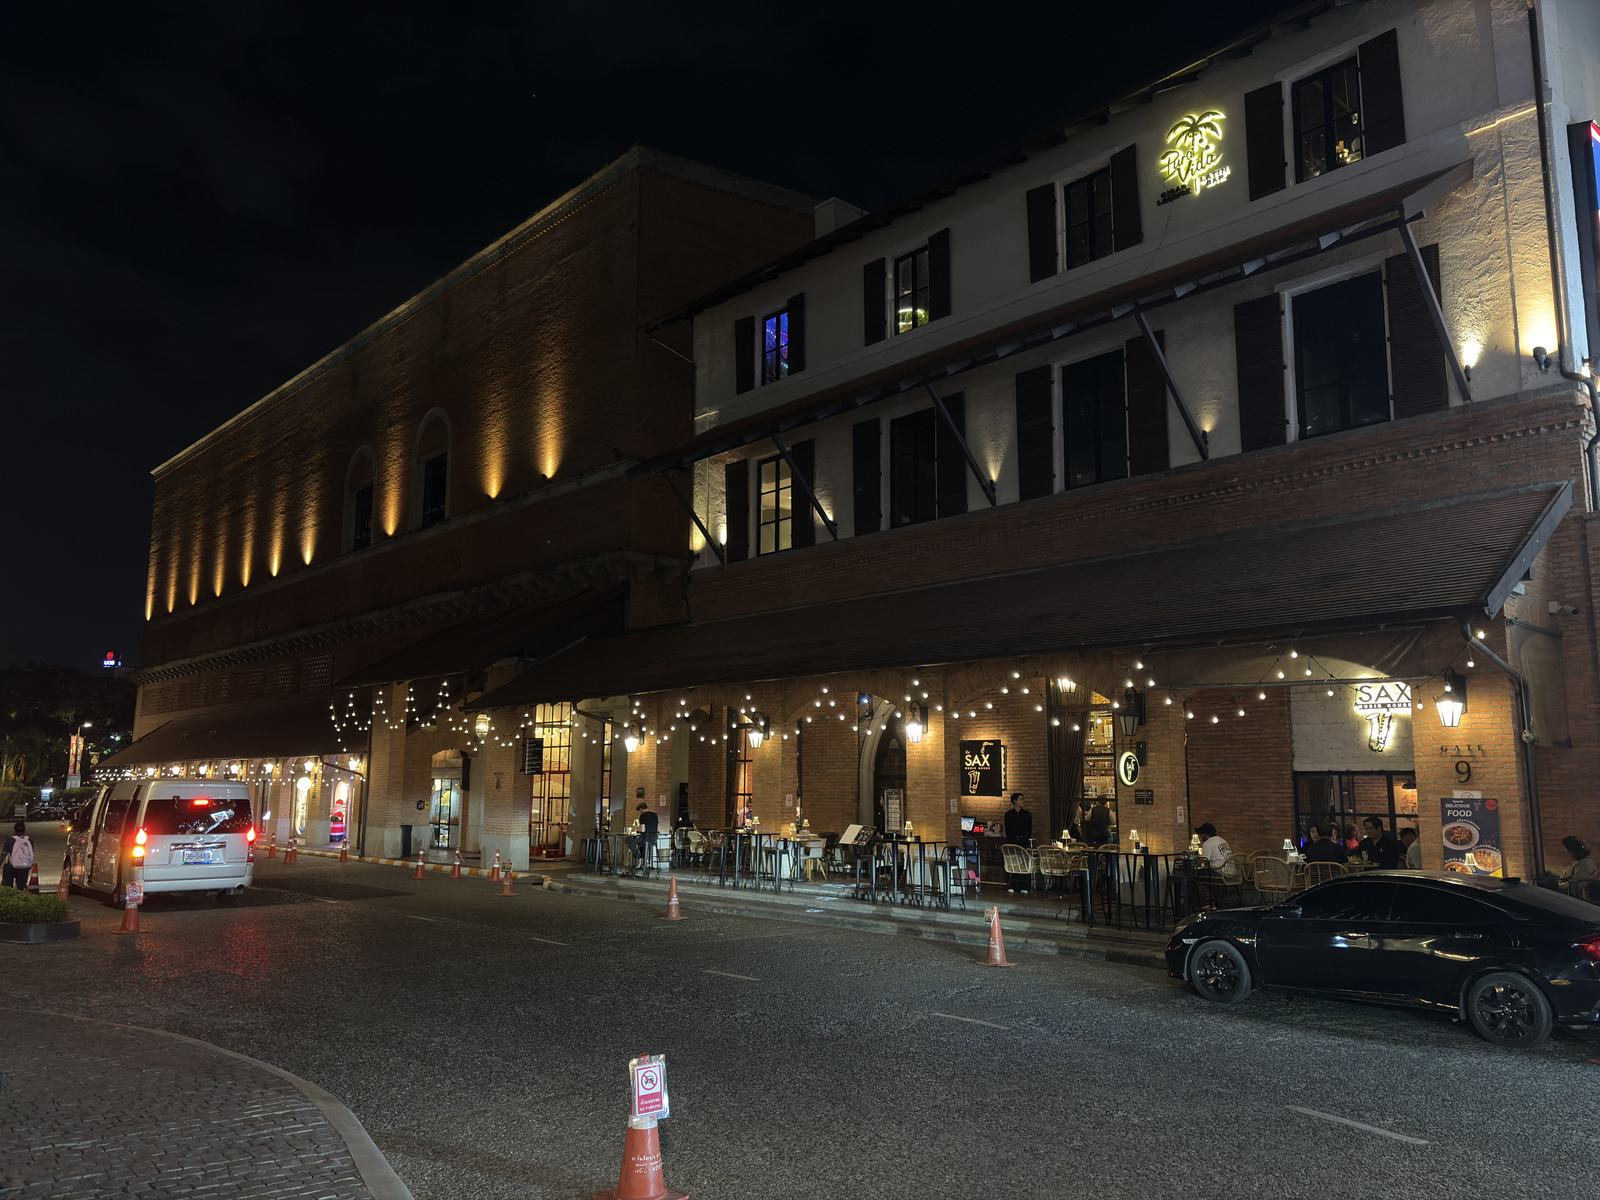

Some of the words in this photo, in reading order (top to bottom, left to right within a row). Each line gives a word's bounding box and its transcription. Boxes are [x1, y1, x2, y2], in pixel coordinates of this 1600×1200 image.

[1174, 152, 1217, 182] Vida
[1359, 684, 1412, 702] SAX
[965, 754, 990, 767] SAX
[1455, 760, 1472, 783] 9
